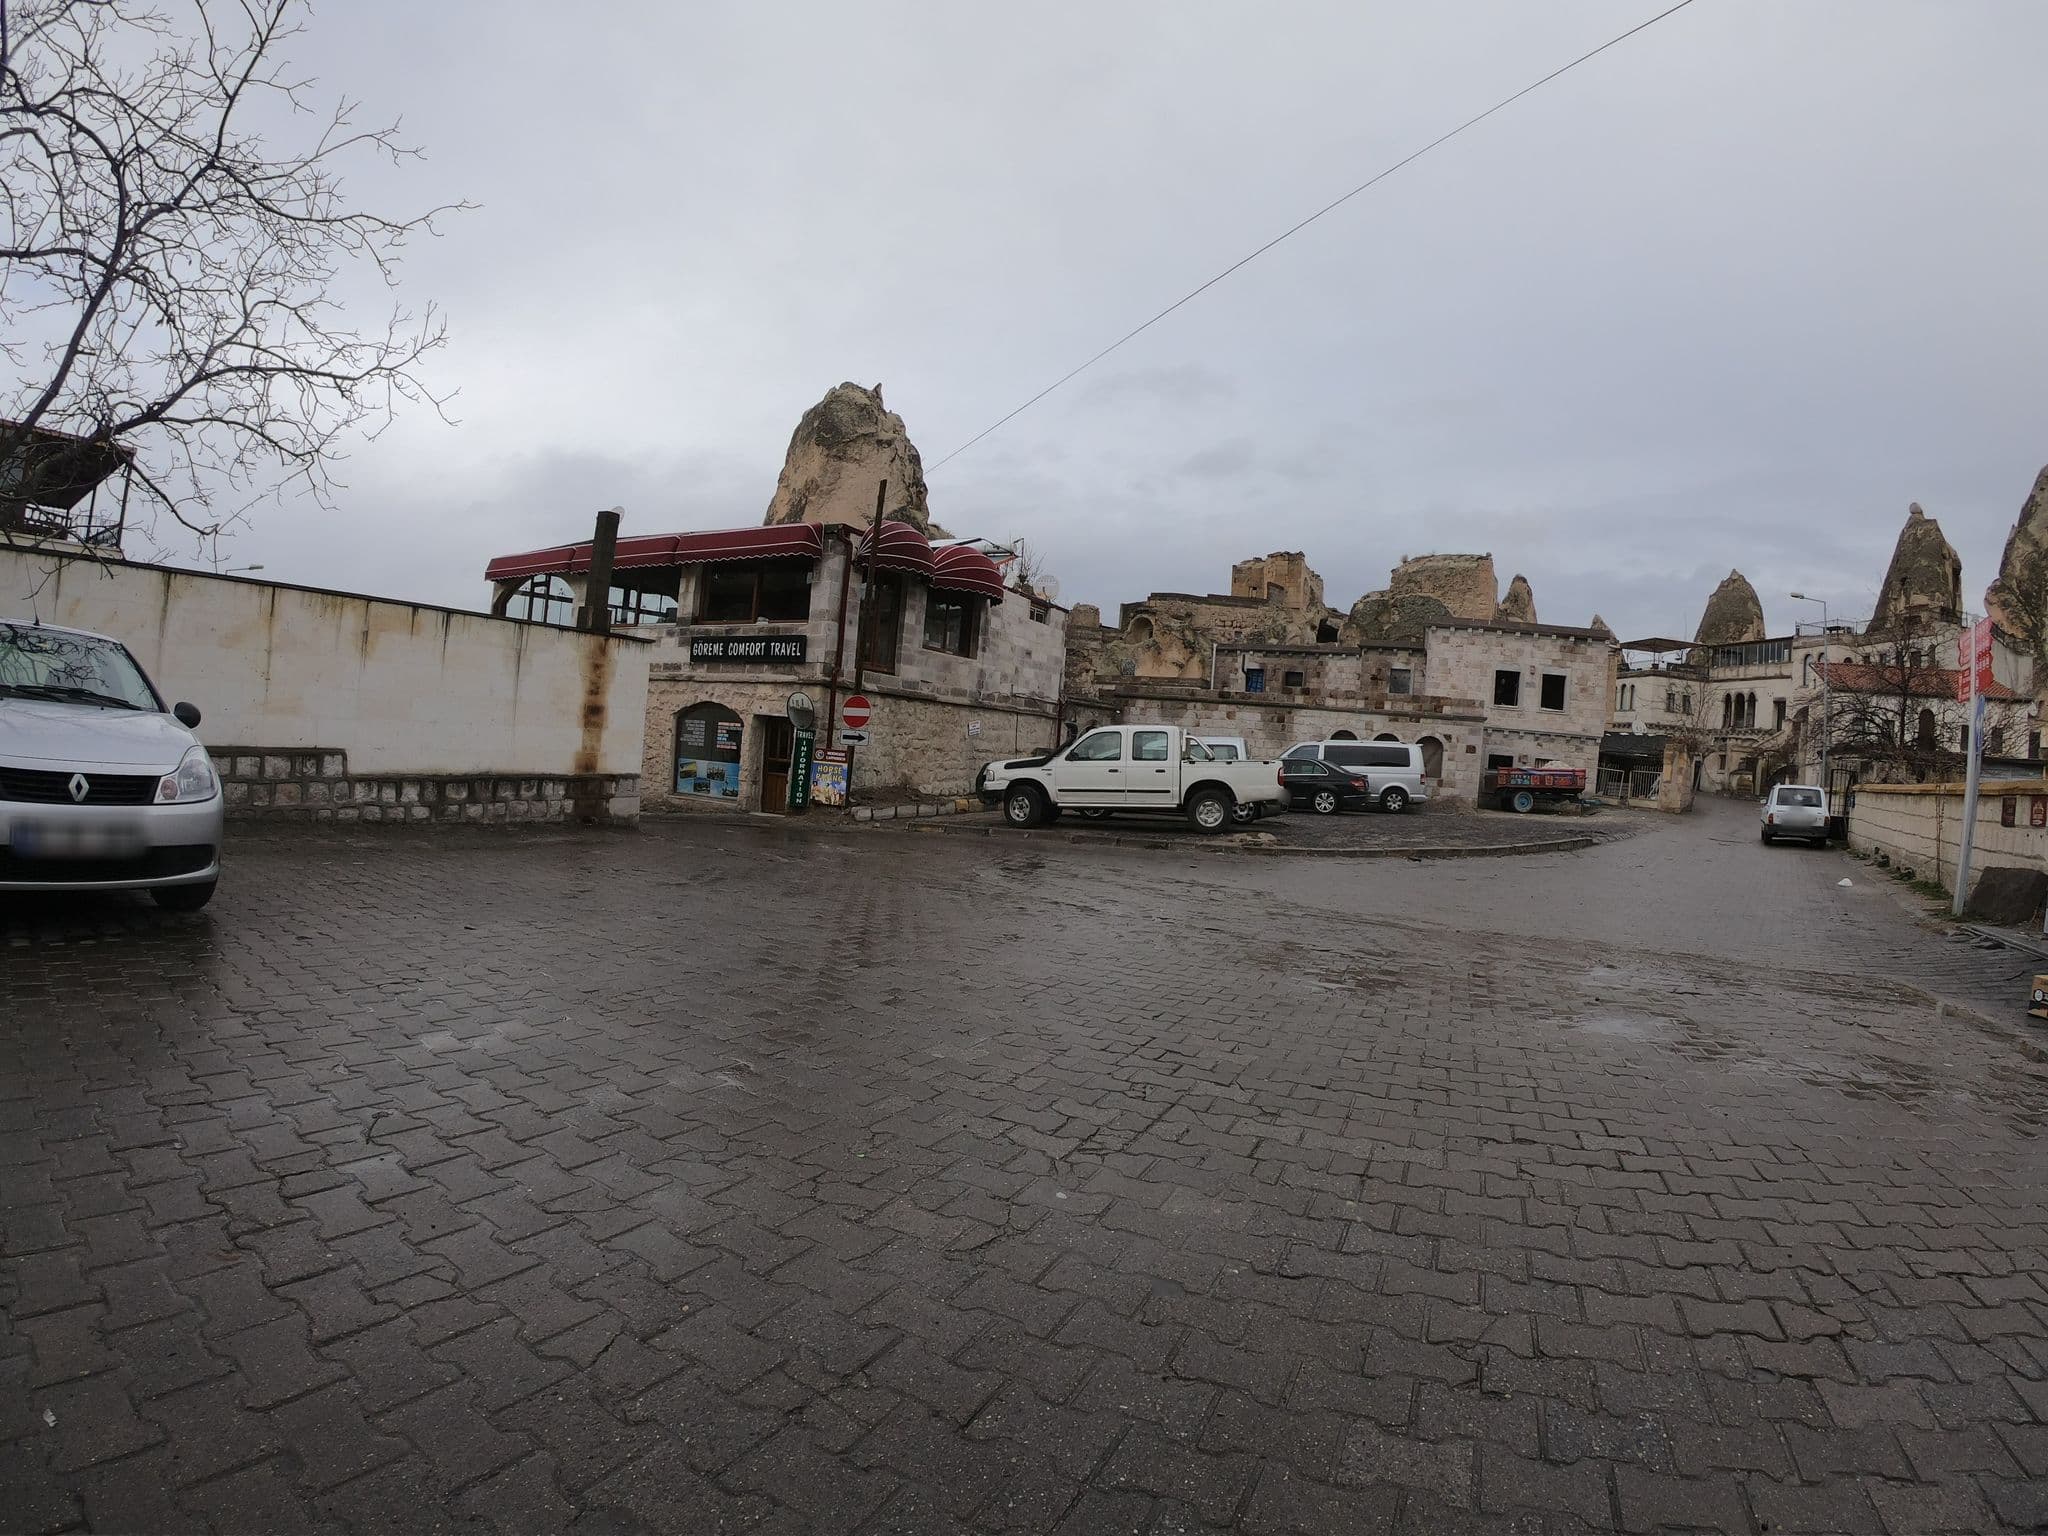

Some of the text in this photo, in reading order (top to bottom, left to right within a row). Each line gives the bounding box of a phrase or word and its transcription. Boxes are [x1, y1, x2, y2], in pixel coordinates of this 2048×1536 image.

[692, 640, 801, 656] GÖREME COMFORT TRAVEL
[797, 730, 814, 740] TRAVEL
[796, 740, 807, 804] INFORMATION
[817, 765, 843, 774] HORSE
